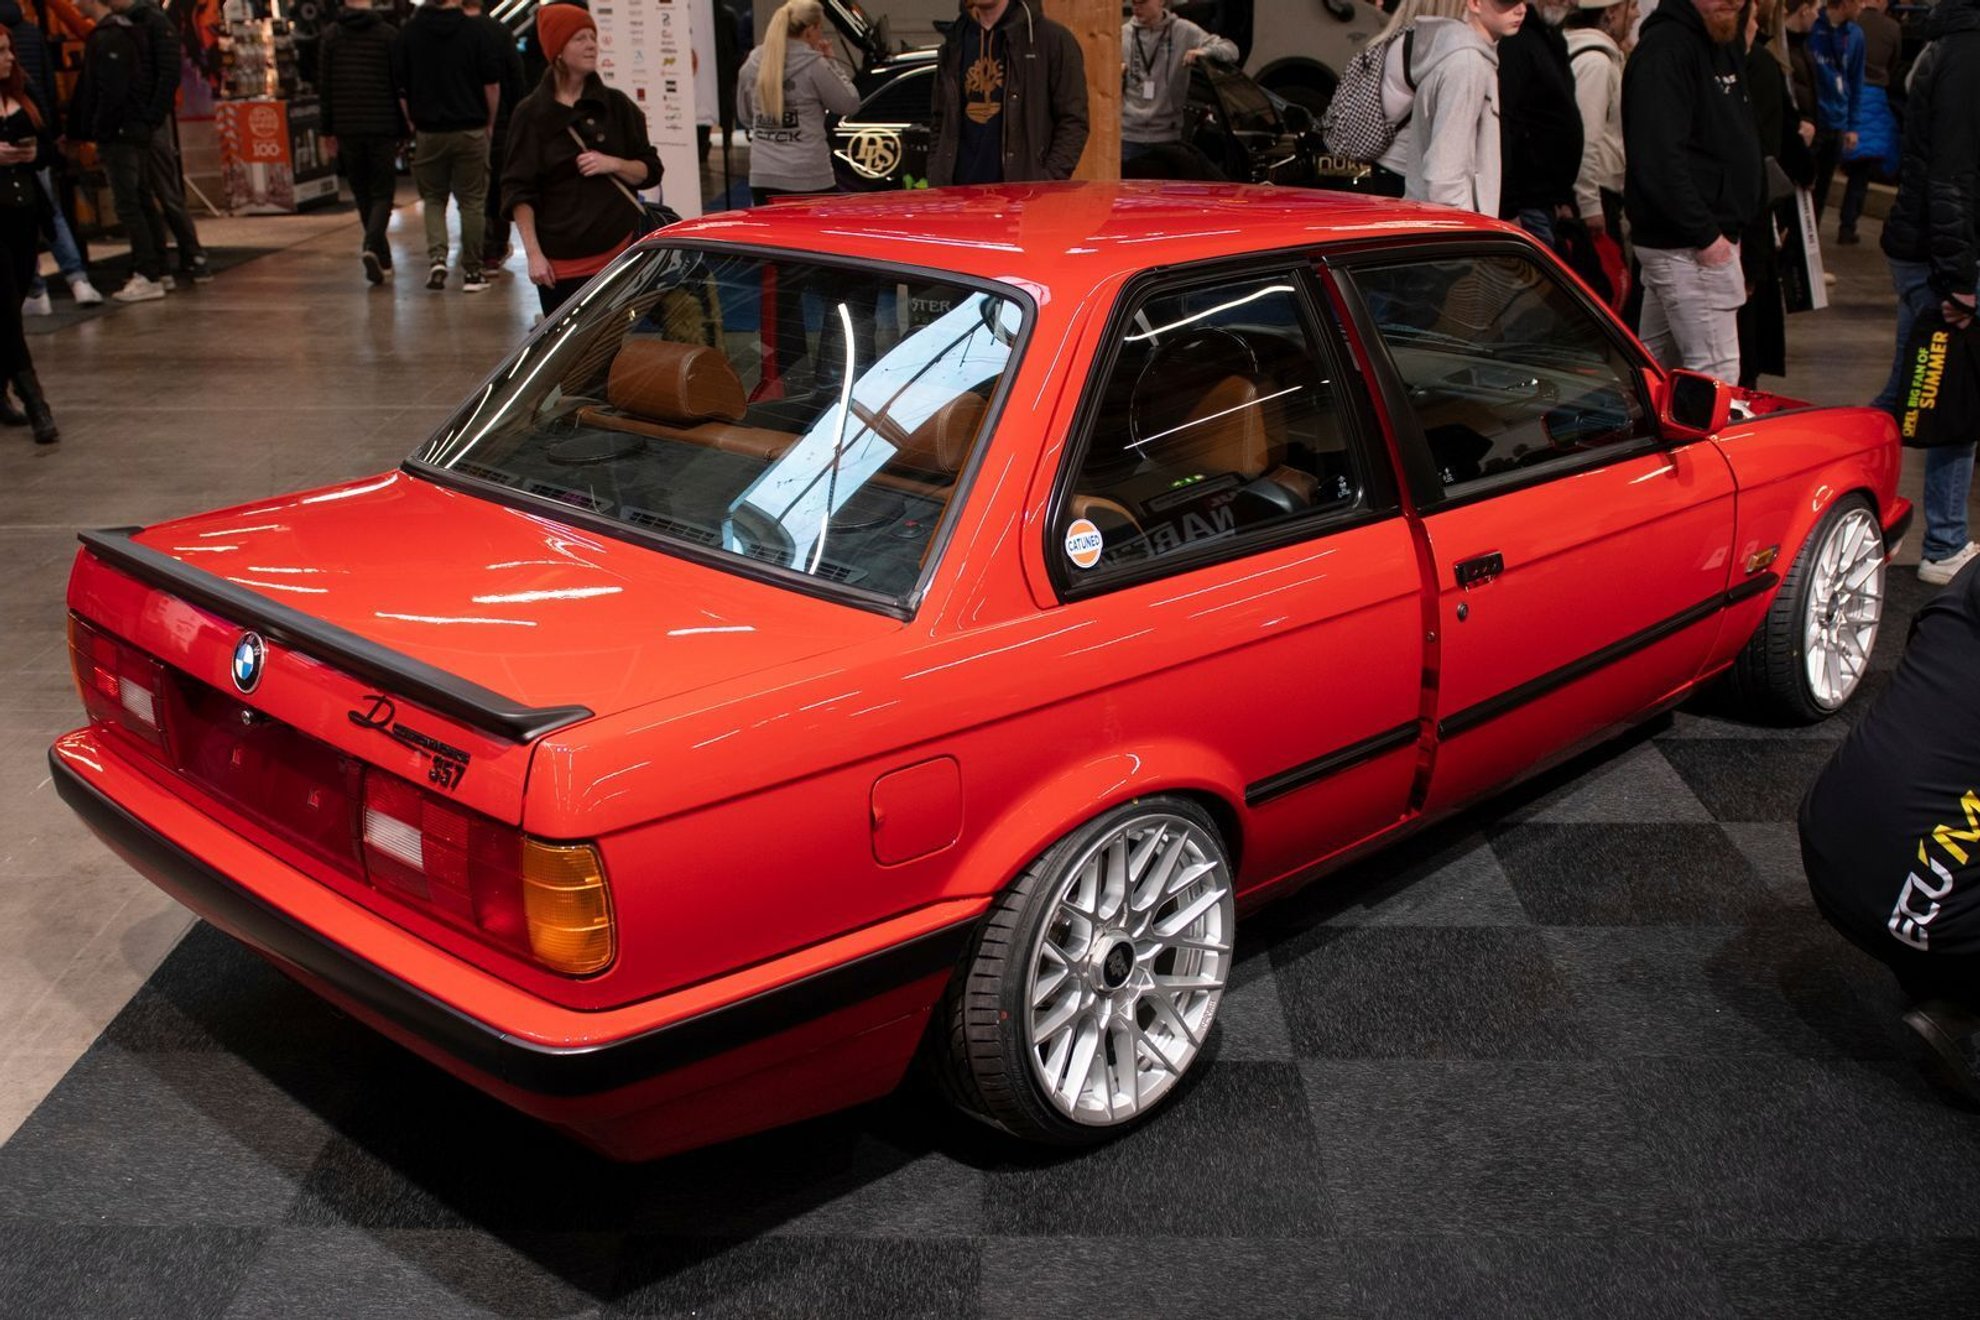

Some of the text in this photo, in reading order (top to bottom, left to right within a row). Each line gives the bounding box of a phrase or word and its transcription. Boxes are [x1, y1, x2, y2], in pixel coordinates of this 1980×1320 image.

[252, 143, 280, 157] 100
[1903, 347, 1929, 437] OPEL BIG FAN OF
[1919, 330, 1949, 409] SUMMER
[1068, 534, 1101, 552] CATUNED
